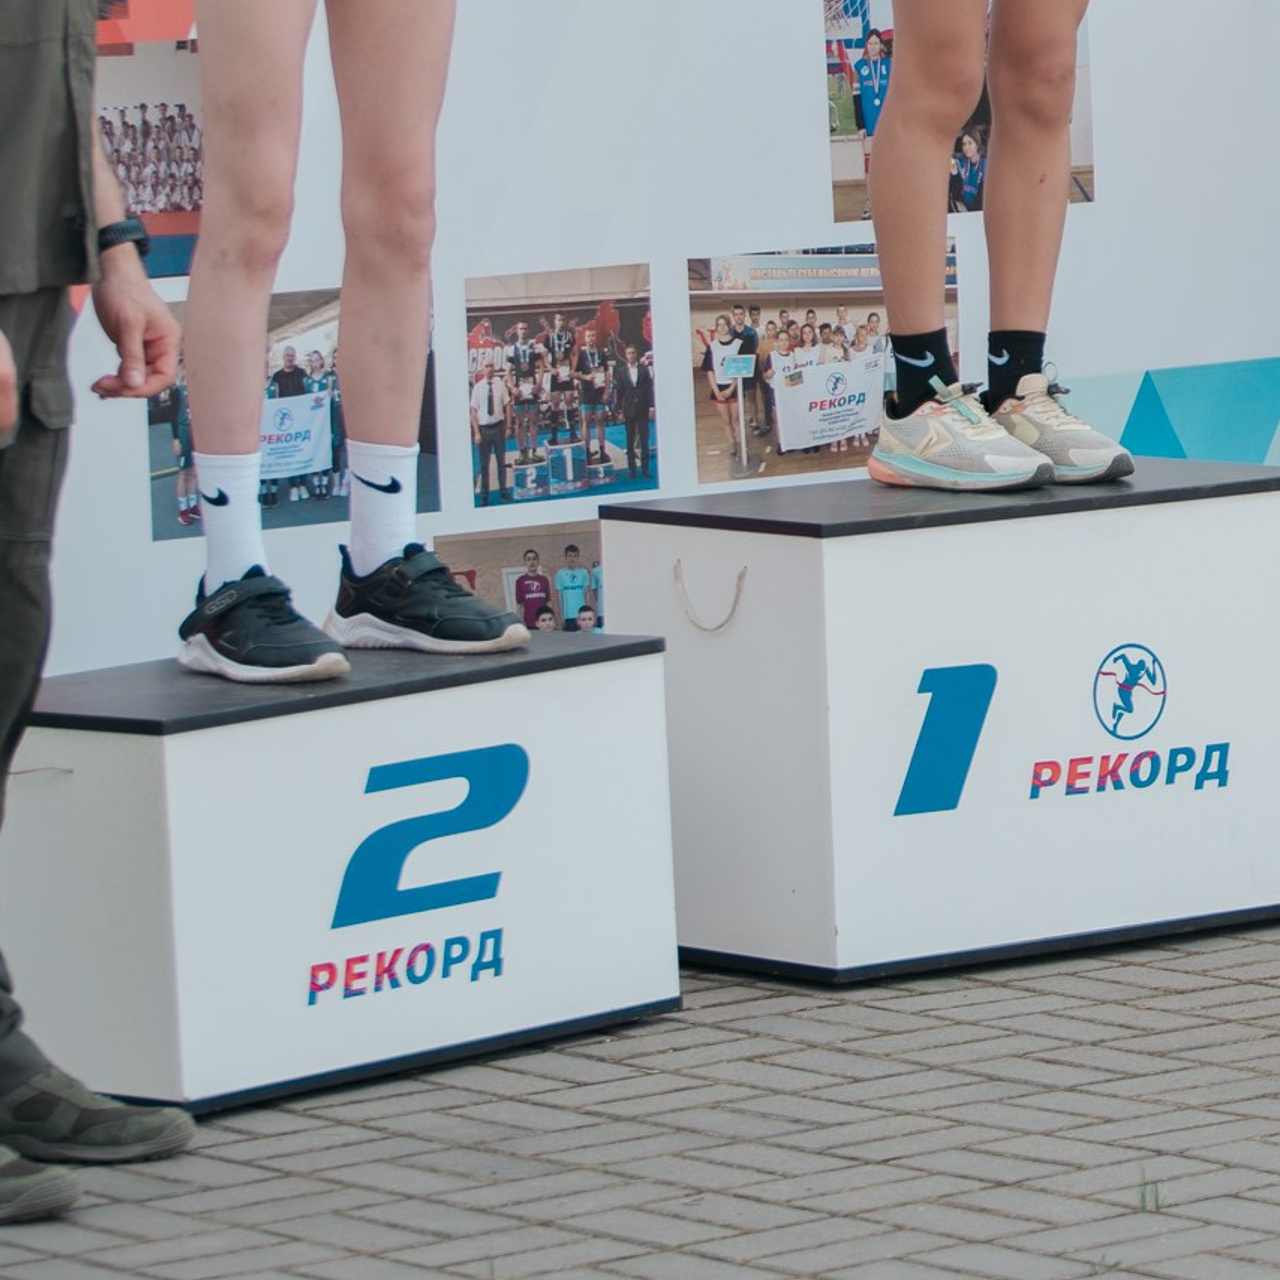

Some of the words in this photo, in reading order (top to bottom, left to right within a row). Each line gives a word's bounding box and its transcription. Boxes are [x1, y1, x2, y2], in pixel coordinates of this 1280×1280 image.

[808, 392, 866, 412] РЕКОРД
[893, 663, 998, 816] 1
[1029, 742, 1231, 800] РЕКОРД
[331, 742, 530, 930] 2
[307, 928, 505, 1007] РЕКОРД
